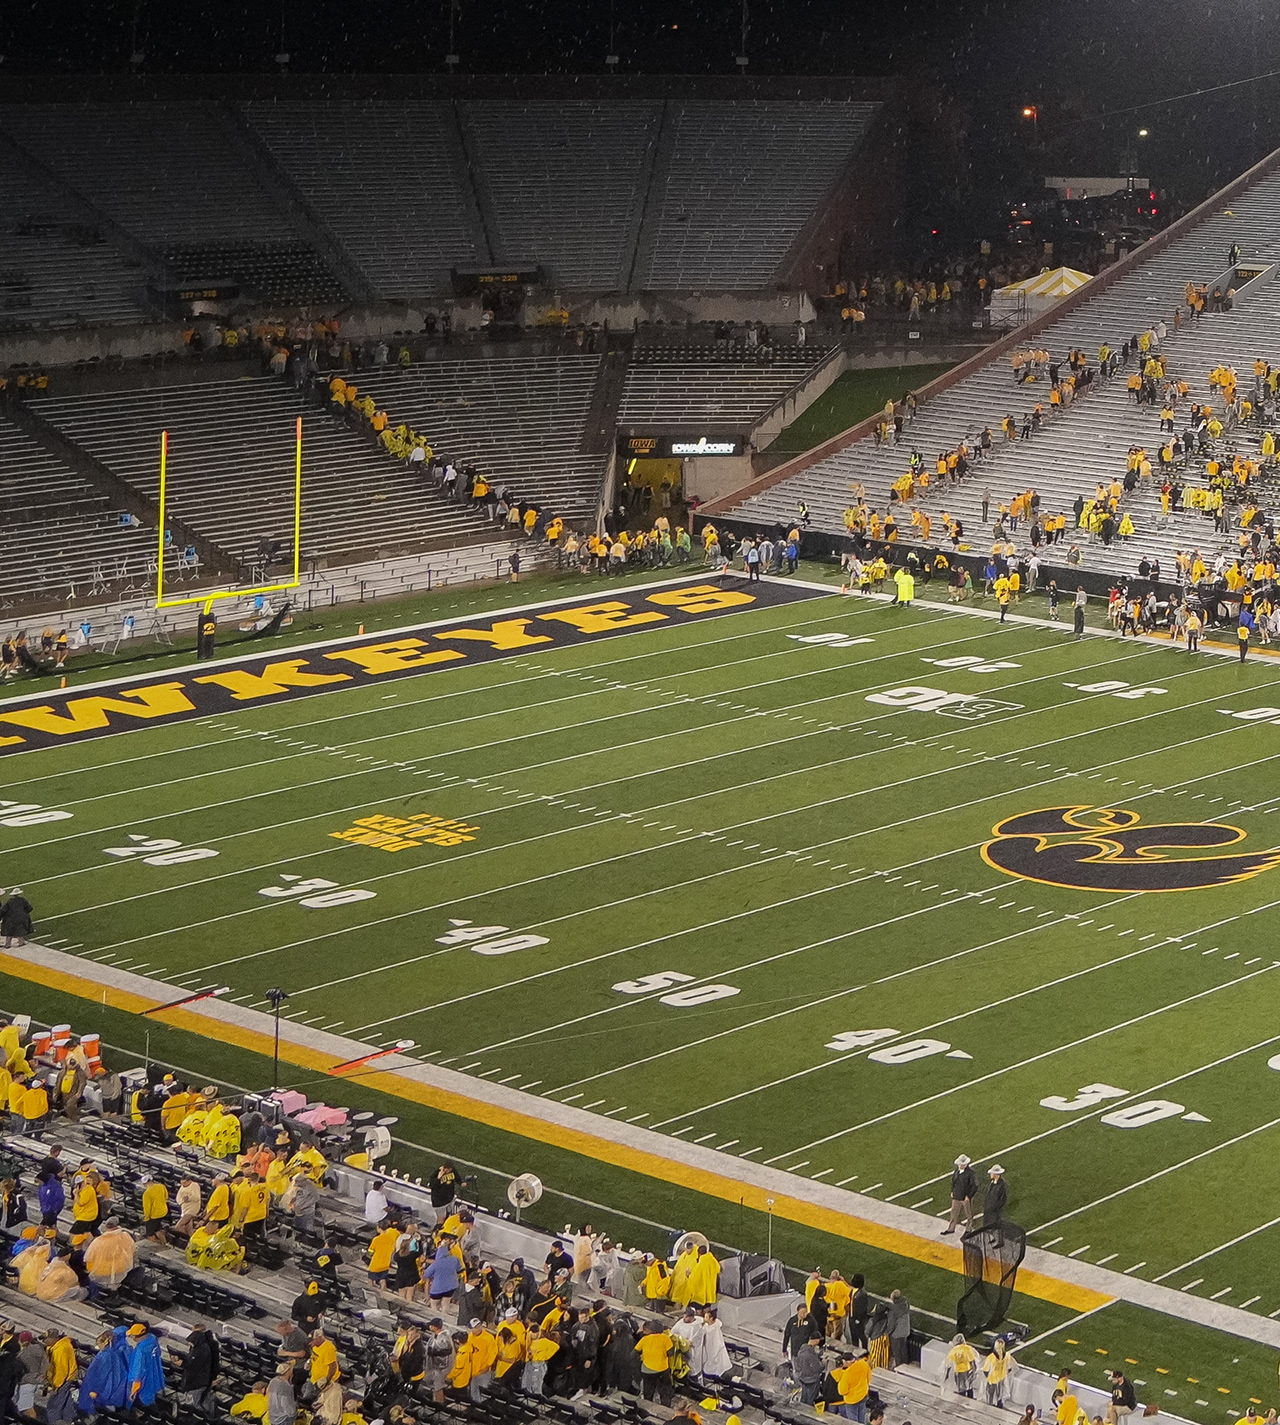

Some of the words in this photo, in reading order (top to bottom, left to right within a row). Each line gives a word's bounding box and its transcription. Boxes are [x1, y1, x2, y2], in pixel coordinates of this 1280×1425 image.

[629, 439, 656, 448] IOWA
[0, 585, 757, 747] WKEYES
[933, 656, 1023, 673] 20
[1077, 680, 1168, 699] 30
[103, 837, 219, 866] 20
[259, 878, 377, 909] 30
[435, 926, 550, 955] 40
[612, 972, 741, 1007] 50
[825, 1029, 953, 1064] 40
[1040, 1083, 1187, 1129] 30
[257, 1192, 265, 1203] 9
